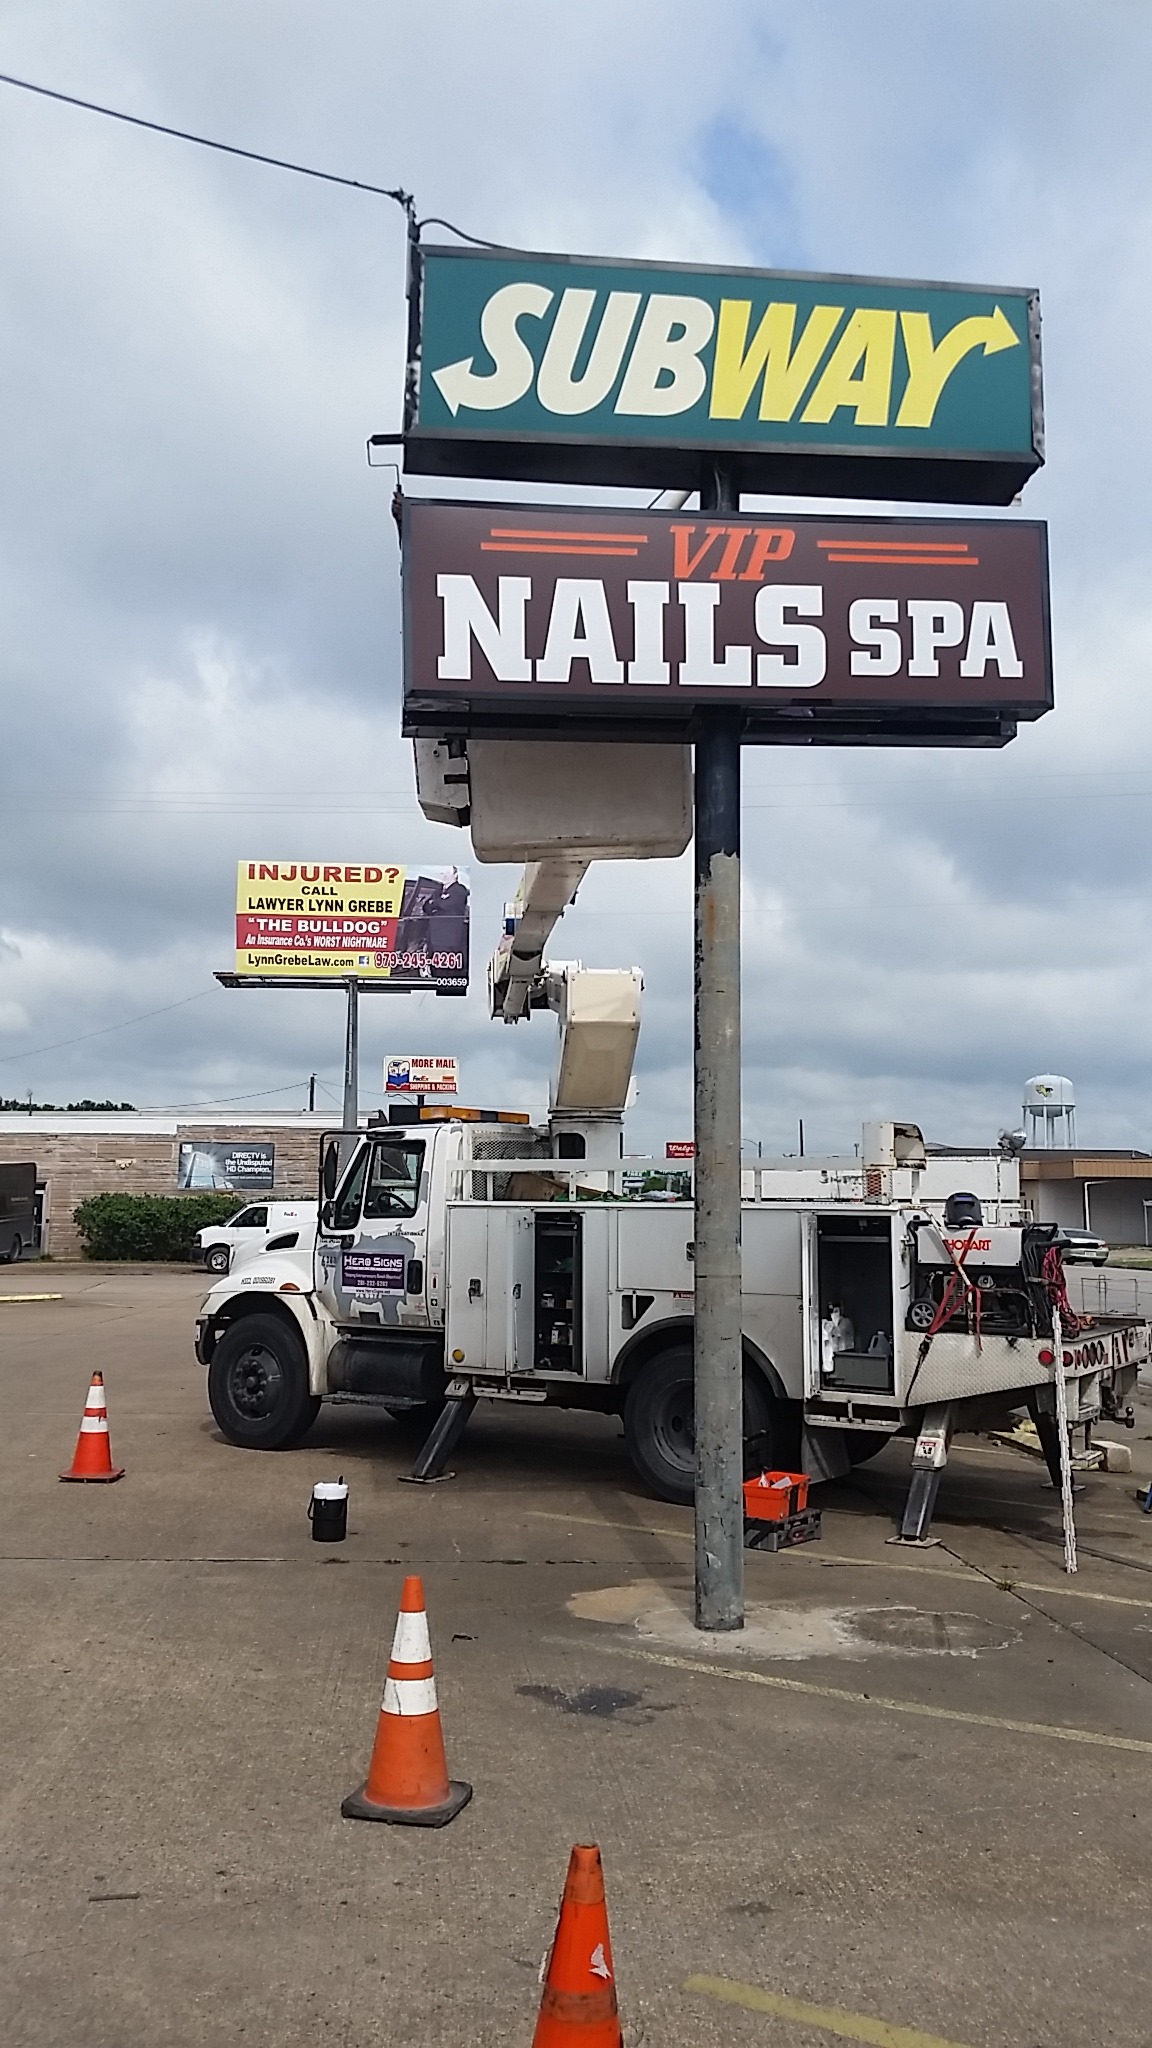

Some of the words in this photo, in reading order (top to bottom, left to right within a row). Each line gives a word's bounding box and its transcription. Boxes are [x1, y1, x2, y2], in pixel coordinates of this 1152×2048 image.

[432, 282, 1021, 429] SUBWAY
[669, 525, 797, 583] VIP
[436, 574, 828, 689] NAILS
[848, 599, 1024, 679] SPA
[248, 863, 400, 884] INJURED?
[301, 886, 338, 896] CALL
[248, 897, 304, 911] LAWYER
[308, 898, 344, 912] LYNN
[348, 900, 393, 913] GREBE
[297, 920, 388, 934] BULLDOG"
[245, 934, 256, 945] An
[256, 934, 293, 946] Insurance
[313, 935, 341, 948] WORST
[342, 936, 388, 949] NIGHTMARE
[248, 953, 354, 967] LynnGrebeLaw.com
[375, 951, 463, 969] 979-245-4261
[437, 978, 468, 986] 003659
[411, 1059, 434, 1068] MORE
[435, 1059, 456, 1069] MAIL
[410, 1083, 431, 1091] SHIPPING
[437, 1083, 456, 1091] PACKING
[237, 1159, 272, 1167] Undisputed
